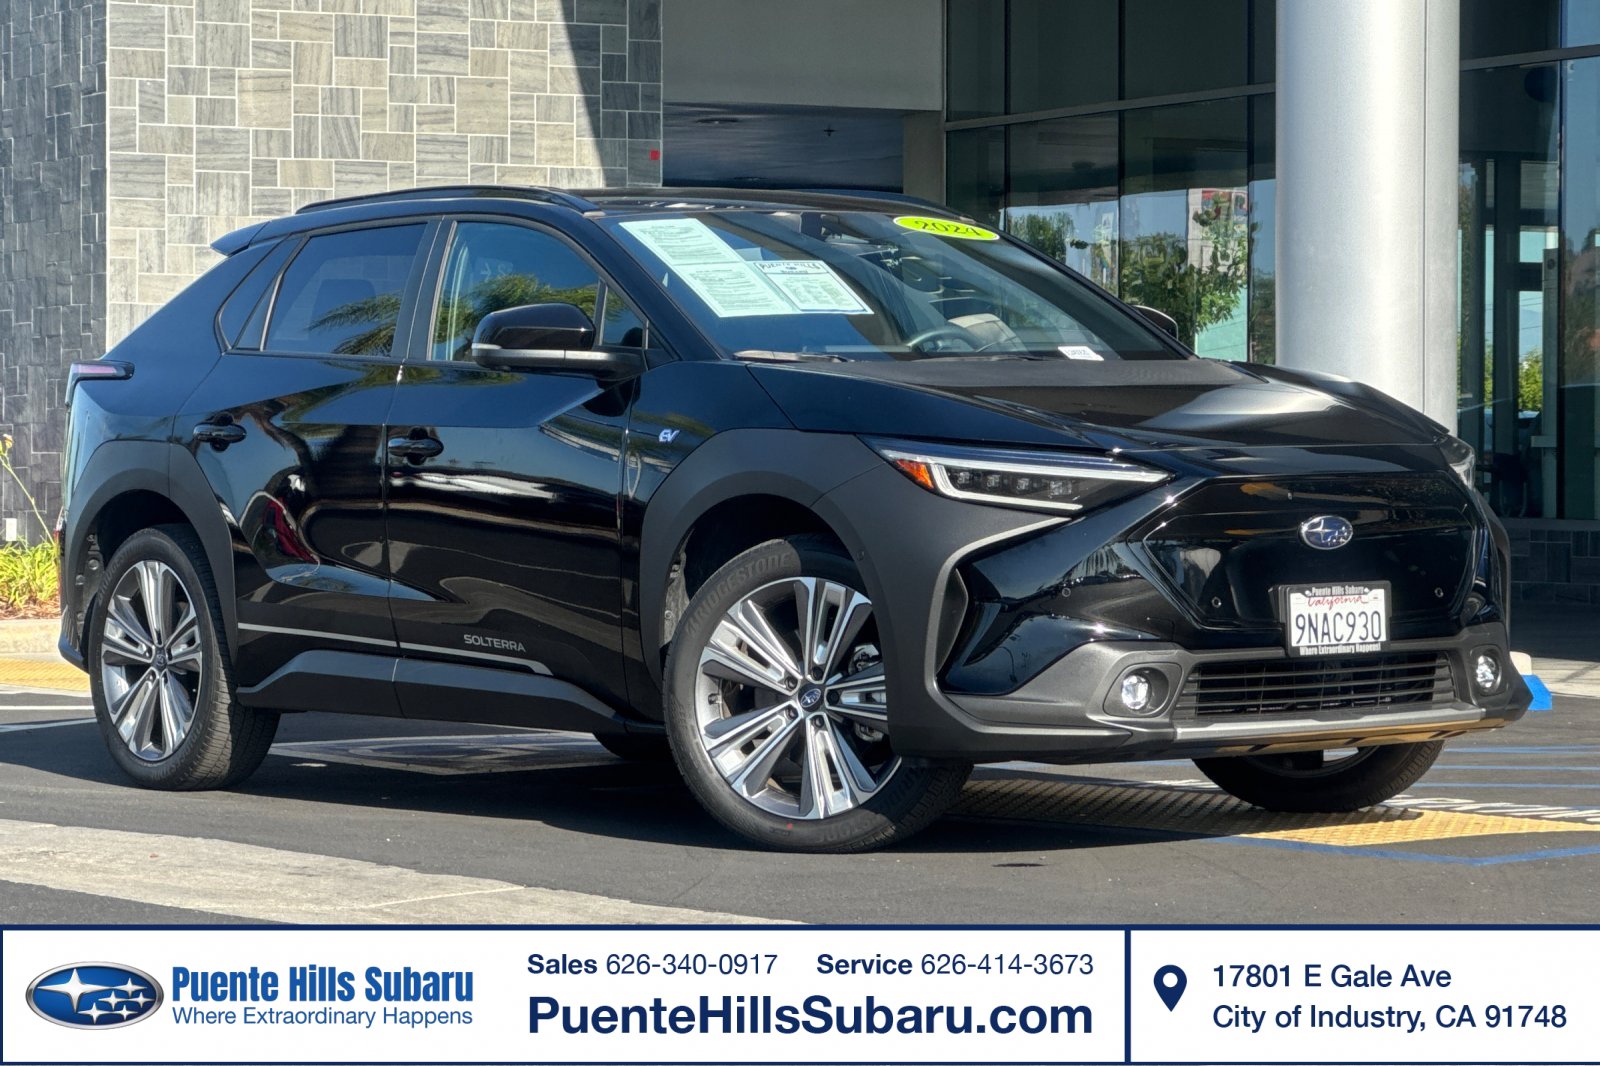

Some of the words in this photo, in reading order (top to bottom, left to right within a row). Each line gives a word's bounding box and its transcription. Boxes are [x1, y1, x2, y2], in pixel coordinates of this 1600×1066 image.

[914, 220, 982, 236] 2024
[659, 429, 680, 442] EV
[1312, 586, 1331, 596] Puente
[1332, 586, 1344, 595] Hills
[1345, 585, 1364, 595] Subaru
[1308, 595, 1369, 611] California
[1295, 610, 1382, 645] 9NAC930
[464, 634, 526, 653] SOLTERRA
[1300, 646, 1318, 656] Where
[1319, 644, 1355, 655] Extraordinary
